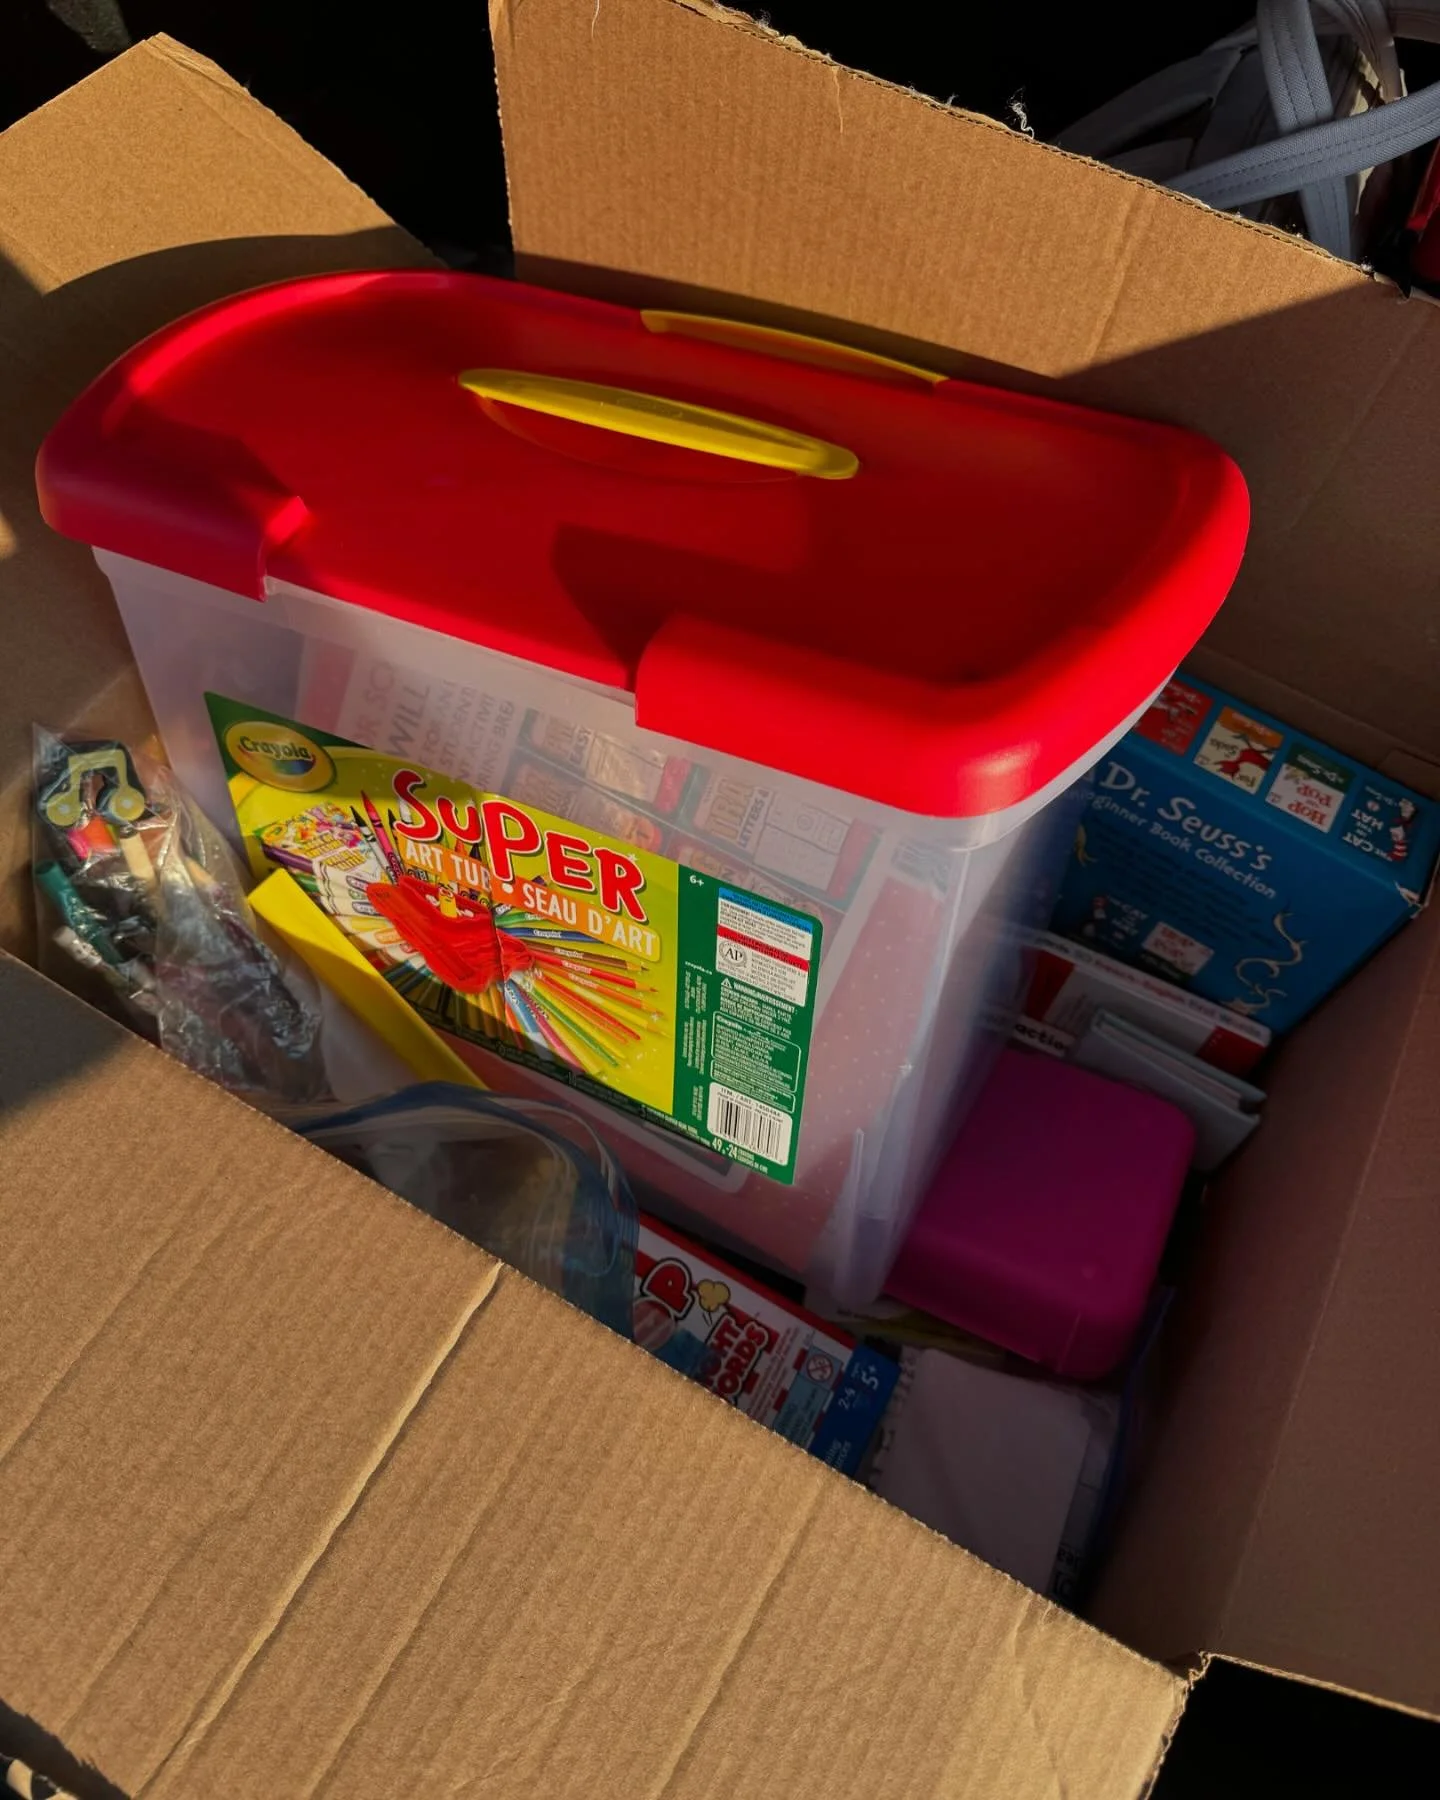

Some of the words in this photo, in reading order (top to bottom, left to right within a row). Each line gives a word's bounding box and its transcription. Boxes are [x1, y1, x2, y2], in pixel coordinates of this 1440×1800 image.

[240, 736, 311, 760] Crayola
[1099, 761, 1150, 808] Dr.
[1157, 797, 1272, 870] Seuss's
[1351, 808, 1385, 831] HAT
[1341, 831, 1375, 853] CAT
[1149, 822, 1192, 853] Book
[1195, 848, 1277, 899] Collection
[689, 875, 704, 887] 6+
[406, 839, 443, 873] ART
[522, 883, 577, 924] SEAU
[588, 909, 657, 956] D'ART
[724, 947, 743, 961] AP
[715, 1321, 769, 1395] ORDS
[860, 1363, 881, 1391] 5+
